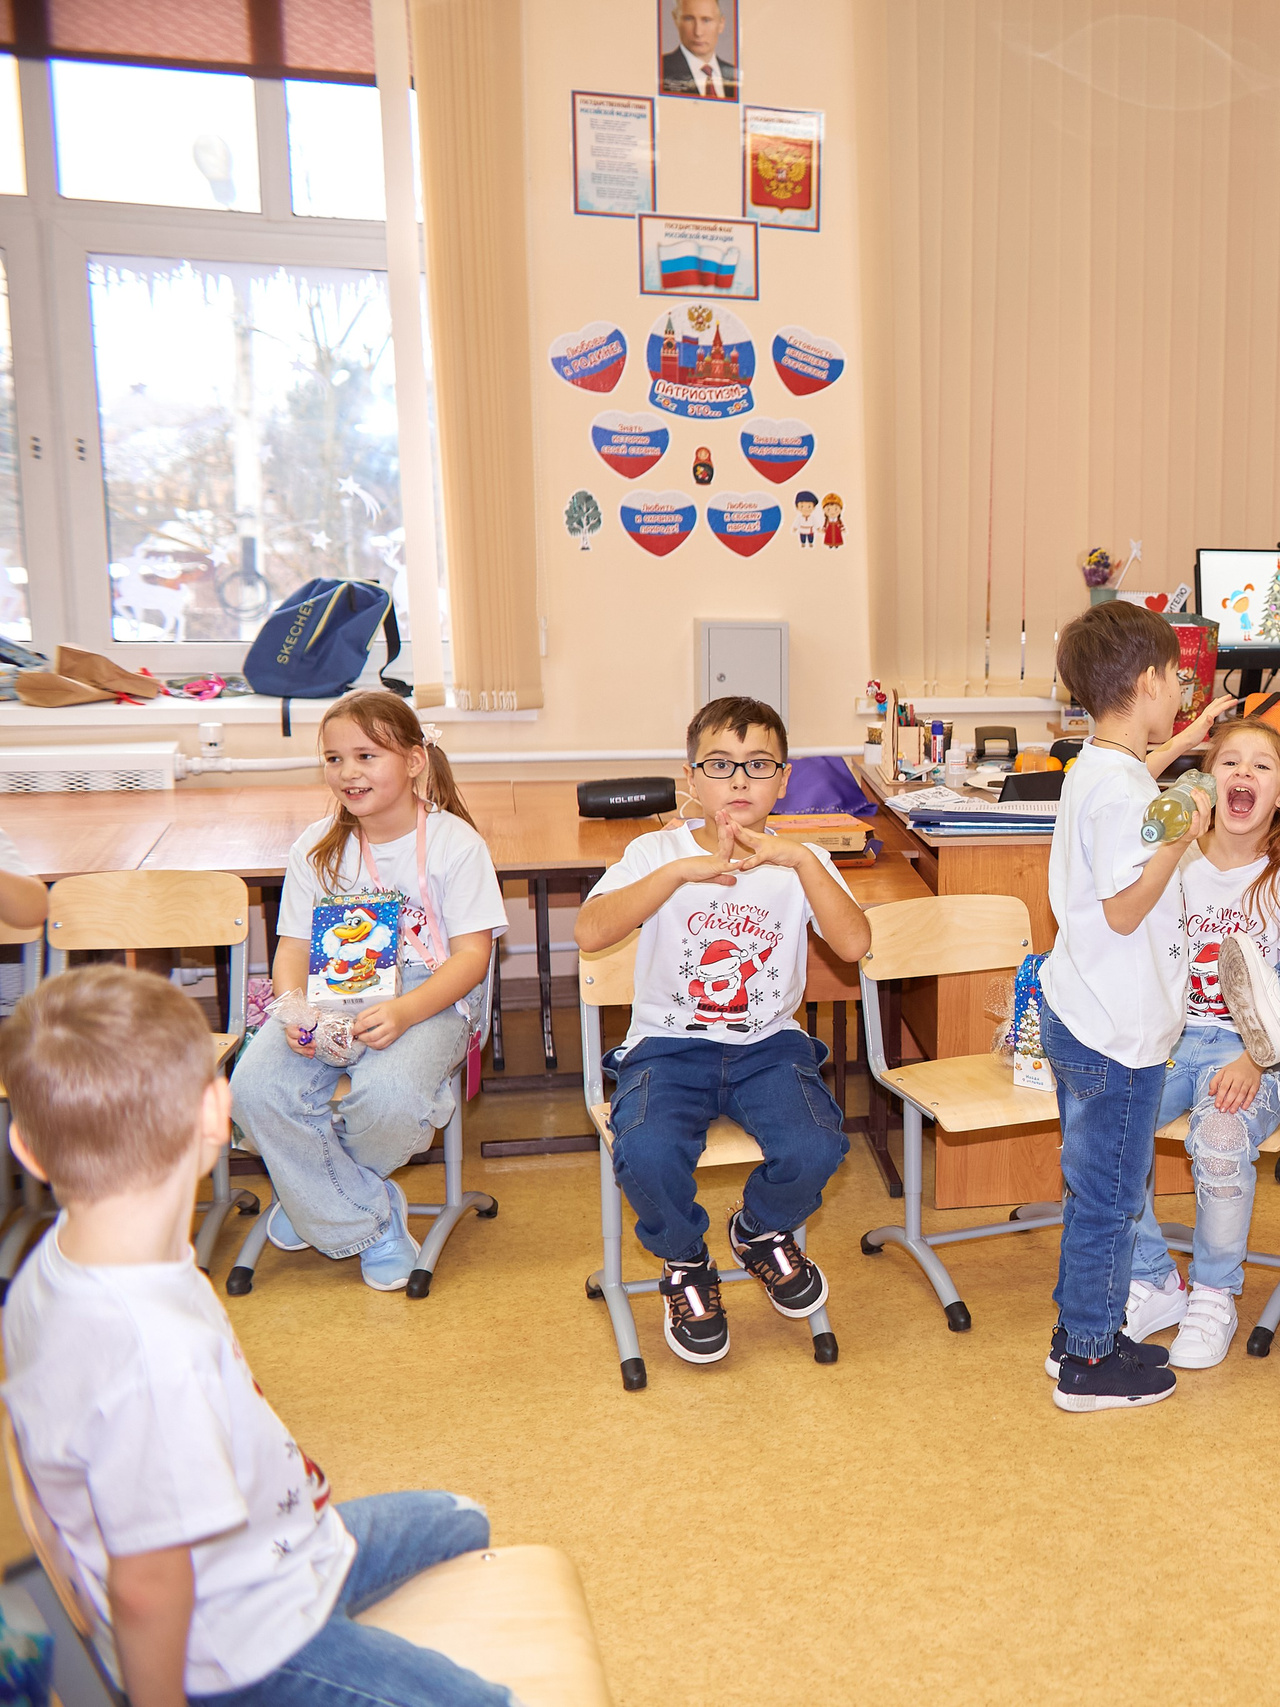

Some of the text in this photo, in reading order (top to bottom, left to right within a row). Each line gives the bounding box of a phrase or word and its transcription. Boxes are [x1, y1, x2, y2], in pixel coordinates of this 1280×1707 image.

[566, 336, 607, 360] Любовь
[571, 341, 623, 372] РОДИНЕ!
[788, 336, 833, 359] Готовность
[656, 380, 747, 401] ПАТРИОТИЗМ-
[618, 424, 643, 432] Знать
[1168, 588, 1187, 612] ИТЕЛЮ
[722, 902, 769, 922] Merry
[687, 911, 783, 948] Christmas
